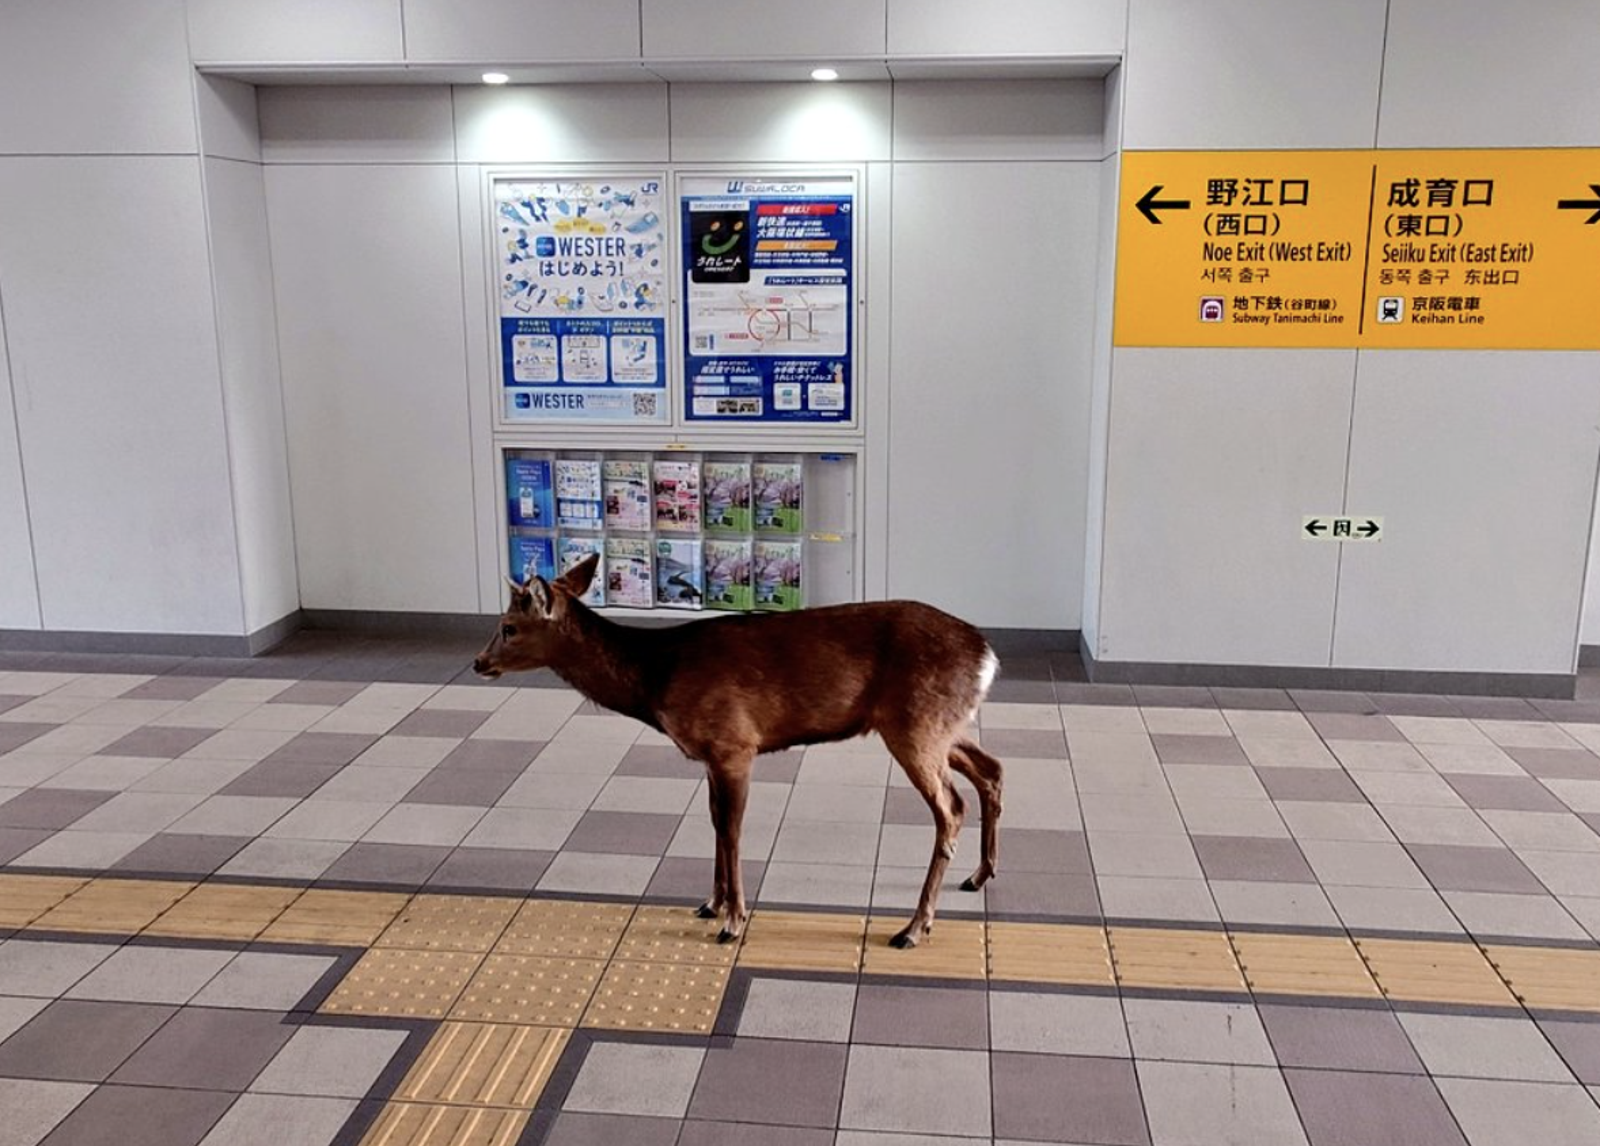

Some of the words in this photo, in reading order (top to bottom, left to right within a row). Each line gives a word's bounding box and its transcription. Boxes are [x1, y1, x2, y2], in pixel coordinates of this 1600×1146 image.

[1206, 178, 1309, 206] 野江口
[1388, 178, 1494, 207] 成育口
[1203, 213, 1281, 236] （西口）
[1383, 214, 1464, 237] （東口）
[558, 237, 626, 257] WESTER
[1203, 242, 1234, 262] Noe
[1237, 242, 1264, 262] Exit
[1269, 242, 1313, 262] (West
[1316, 242, 1352, 262] Exit)
[1382, 243, 1426, 263] Seiiku
[1429, 243, 1456, 263] Exit
[1460, 243, 1497, 263] (East
[1500, 243, 1534, 263] Exit)
[539, 261, 624, 277] はじめよう！
[1201, 267, 1233, 284] 서쪽
[1239, 268, 1271, 284] 출구
[1379, 268, 1412, 285] 동쪽
[1418, 268, 1451, 285] 출구
[1464, 269, 1519, 285] 东出口
[1412, 297, 1481, 311] 京阪電車
[1232, 313, 1270, 325] Subway
[1273, 313, 1322, 324] Tanimachi
[1324, 313, 1344, 324] Line
[1412, 314, 1455, 325] Keihan
[1458, 314, 1485, 325] Line
[533, 393, 584, 409] WESTER
